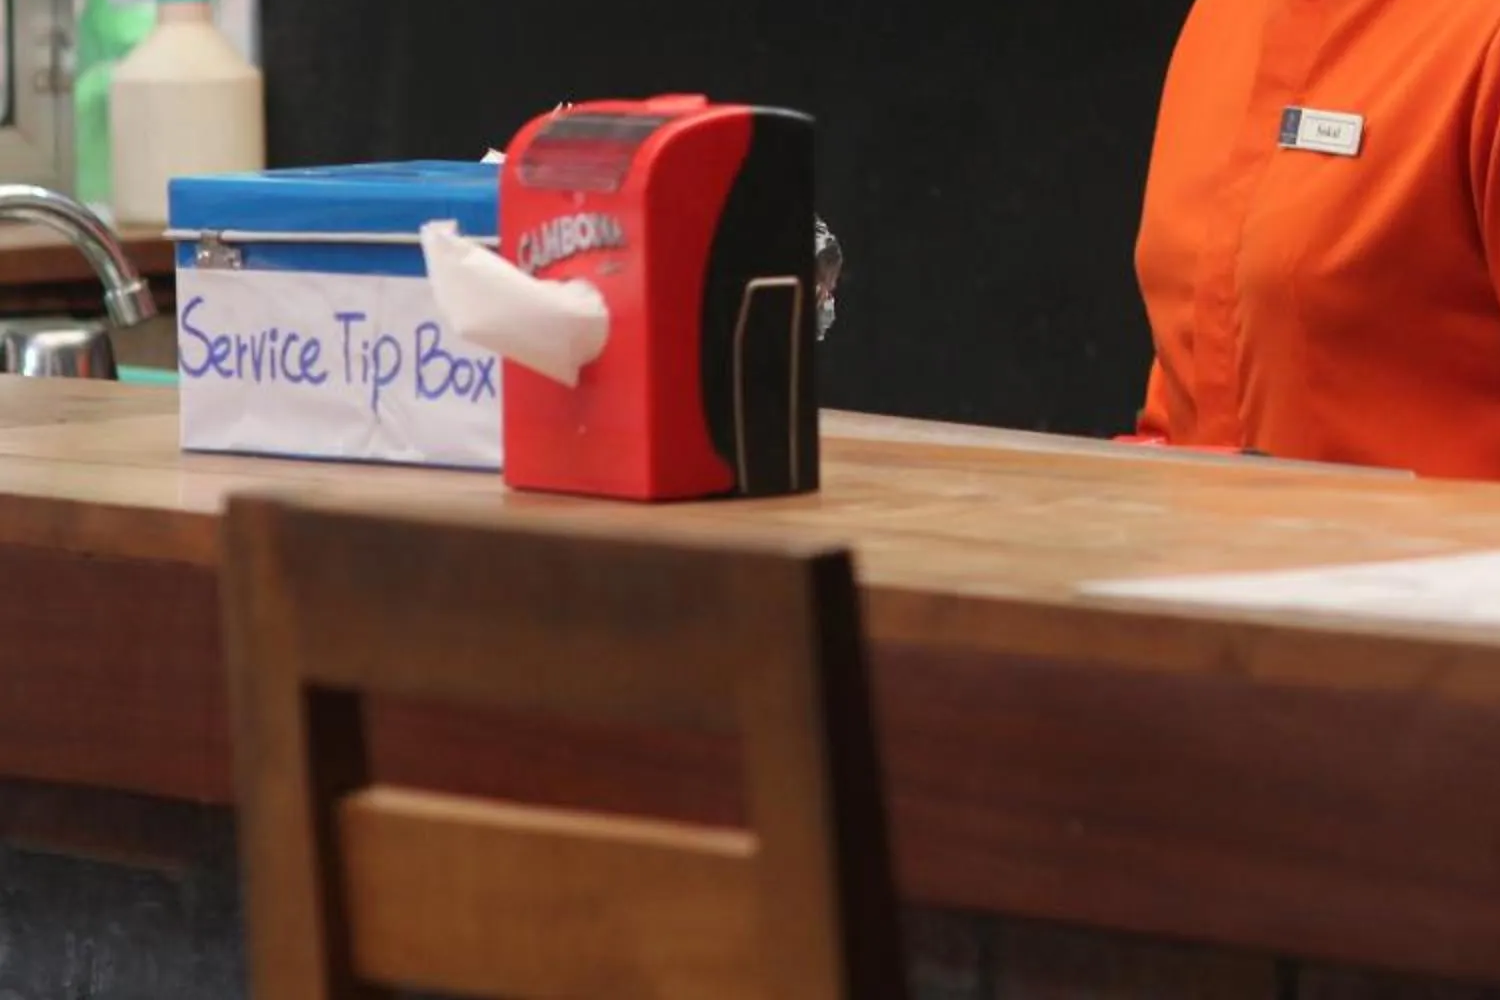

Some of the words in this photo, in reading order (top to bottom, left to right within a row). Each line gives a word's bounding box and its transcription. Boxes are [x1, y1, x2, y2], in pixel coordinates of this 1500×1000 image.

[178, 295, 329, 385] Service
[334, 312, 403, 416] Tip
[415, 321, 497, 403] Box
